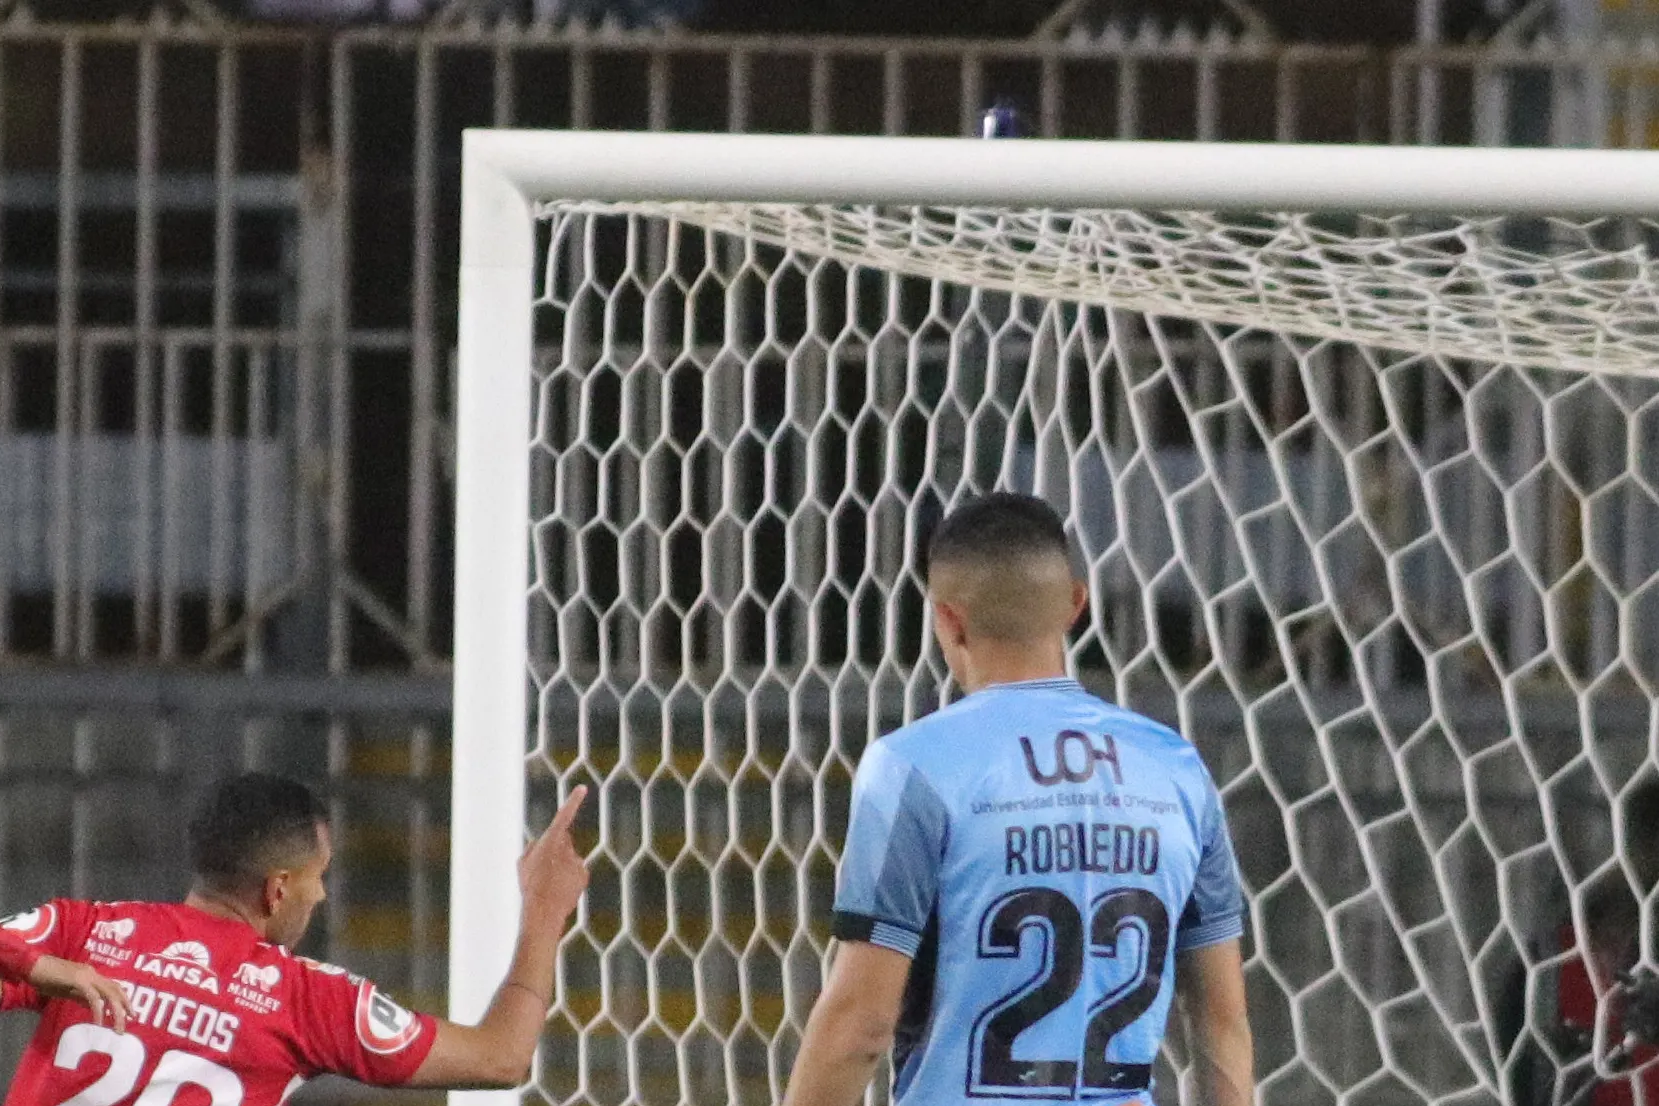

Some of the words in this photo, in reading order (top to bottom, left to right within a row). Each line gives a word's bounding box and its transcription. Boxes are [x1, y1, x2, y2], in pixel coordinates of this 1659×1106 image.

[1004, 822, 1160, 876] ROBLEDO
[133, 954, 220, 995] IANSA
[226, 982, 281, 1012] MARLEY
[965, 885, 1176, 1101] 22
